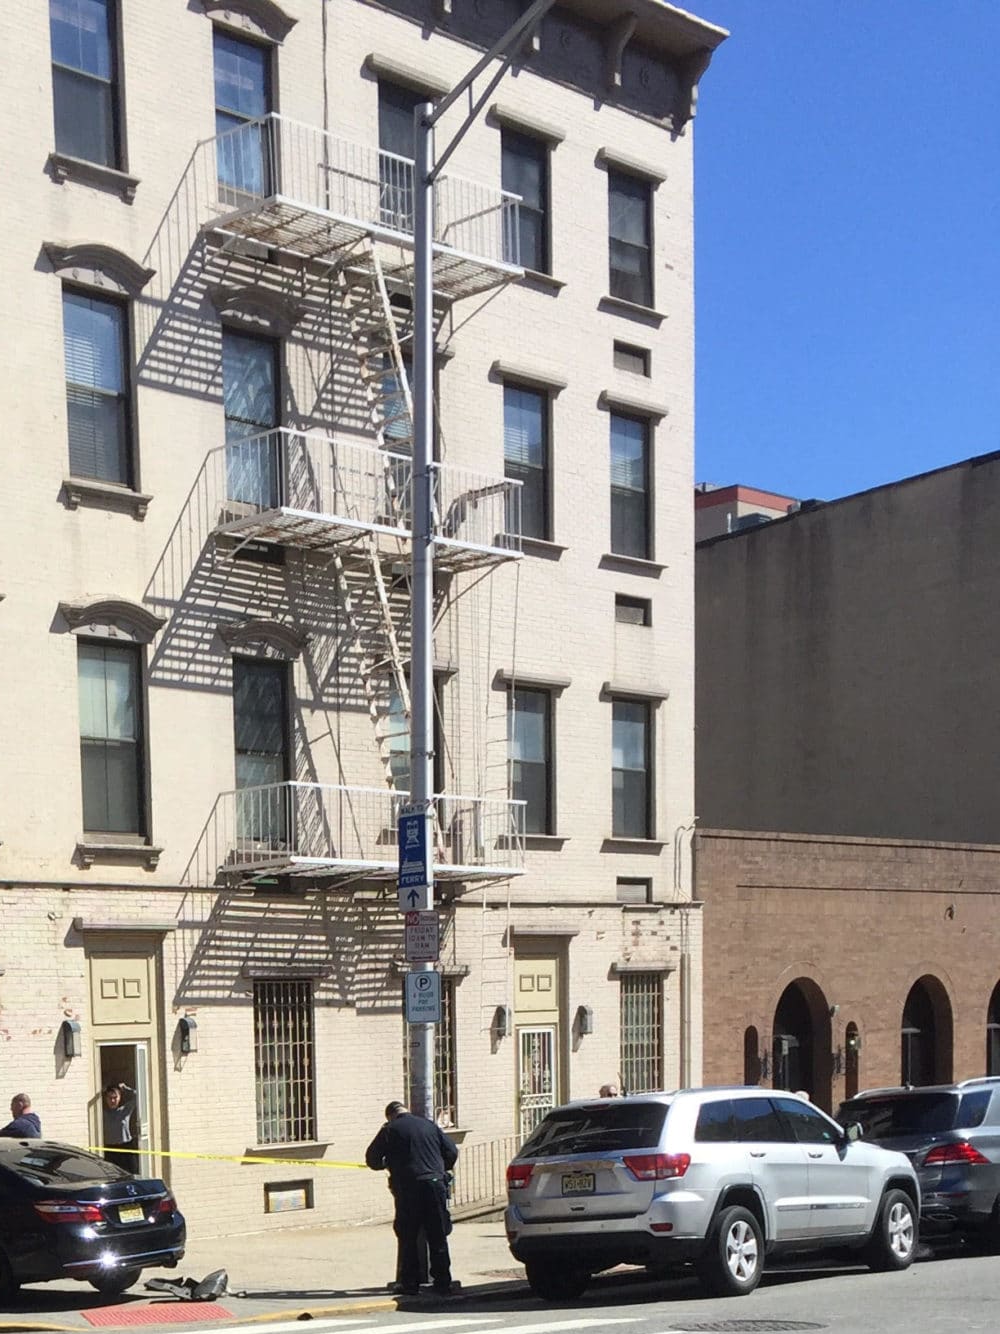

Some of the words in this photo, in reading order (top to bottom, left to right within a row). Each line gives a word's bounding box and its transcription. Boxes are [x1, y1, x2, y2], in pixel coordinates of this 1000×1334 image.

[402, 875, 425, 885] FERRY
[407, 913, 420, 925] NO
[419, 977, 428, 988] P
